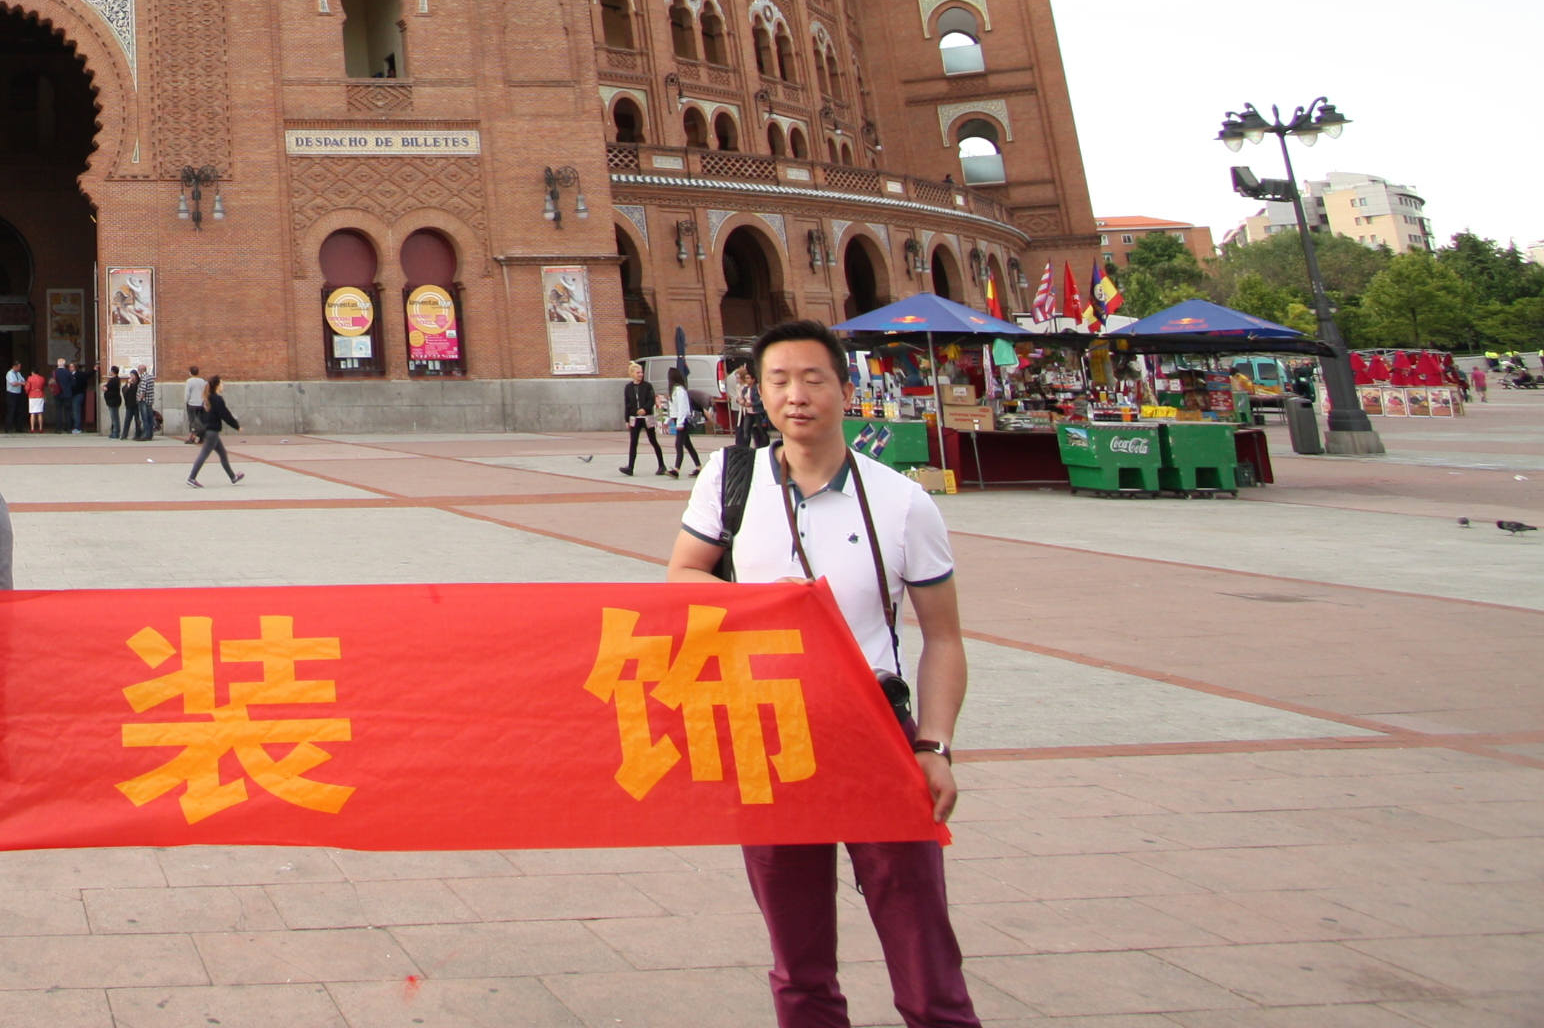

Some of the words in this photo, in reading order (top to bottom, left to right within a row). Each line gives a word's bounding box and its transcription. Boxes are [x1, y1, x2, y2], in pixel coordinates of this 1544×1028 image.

[295, 136, 368, 147] DESPACHO
[375, 137, 393, 147] DE
[401, 137, 470, 147] BILLETES
